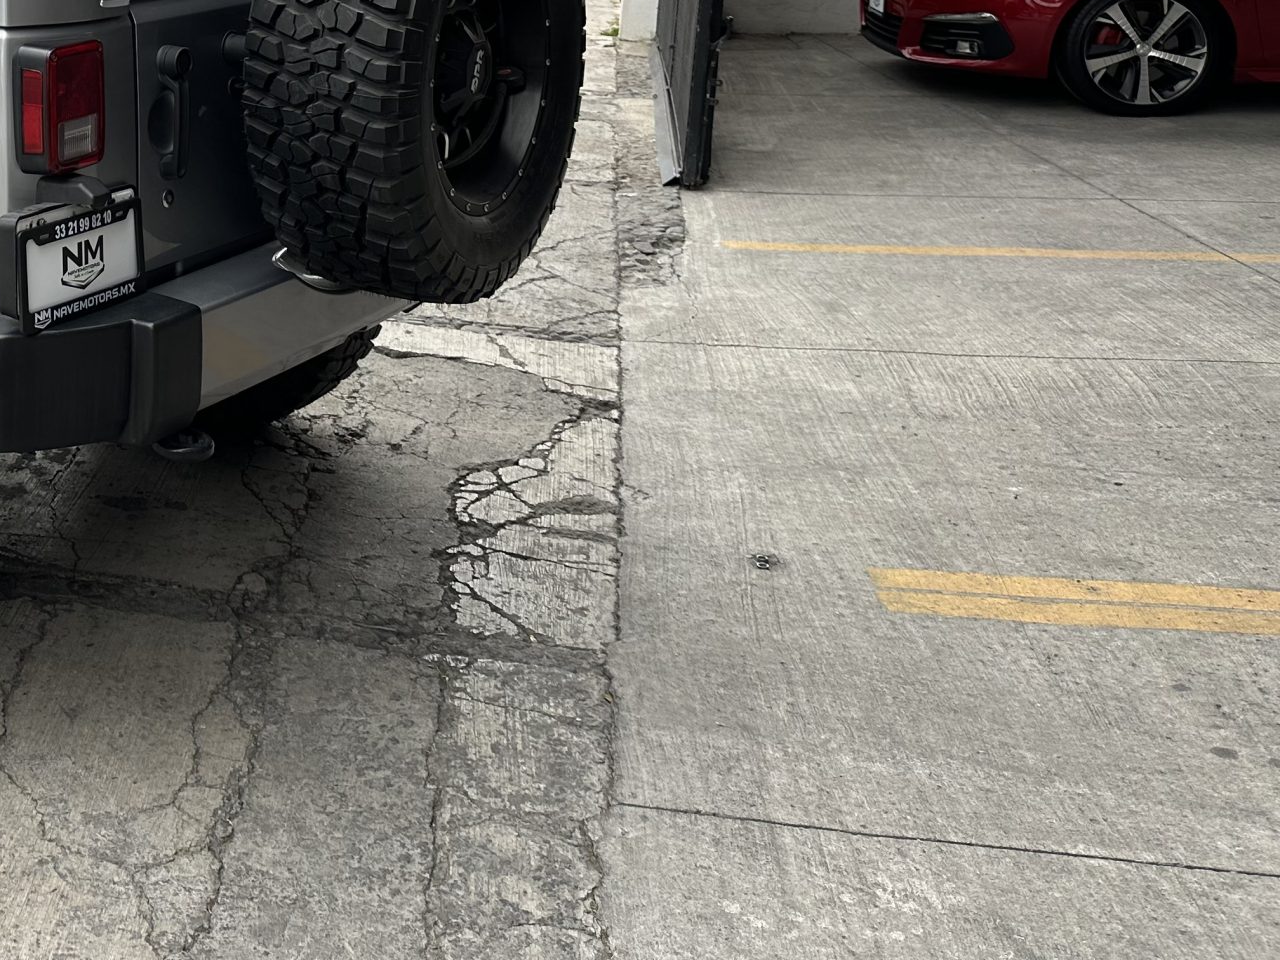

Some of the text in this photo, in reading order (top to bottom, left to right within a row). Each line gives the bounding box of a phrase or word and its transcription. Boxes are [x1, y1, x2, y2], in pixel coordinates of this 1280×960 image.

[54, 209, 112, 239] 33 21 99 82 10
[62, 234, 104, 277] NM
[34, 282, 136, 323] NM NAVEMOTORS.MX
